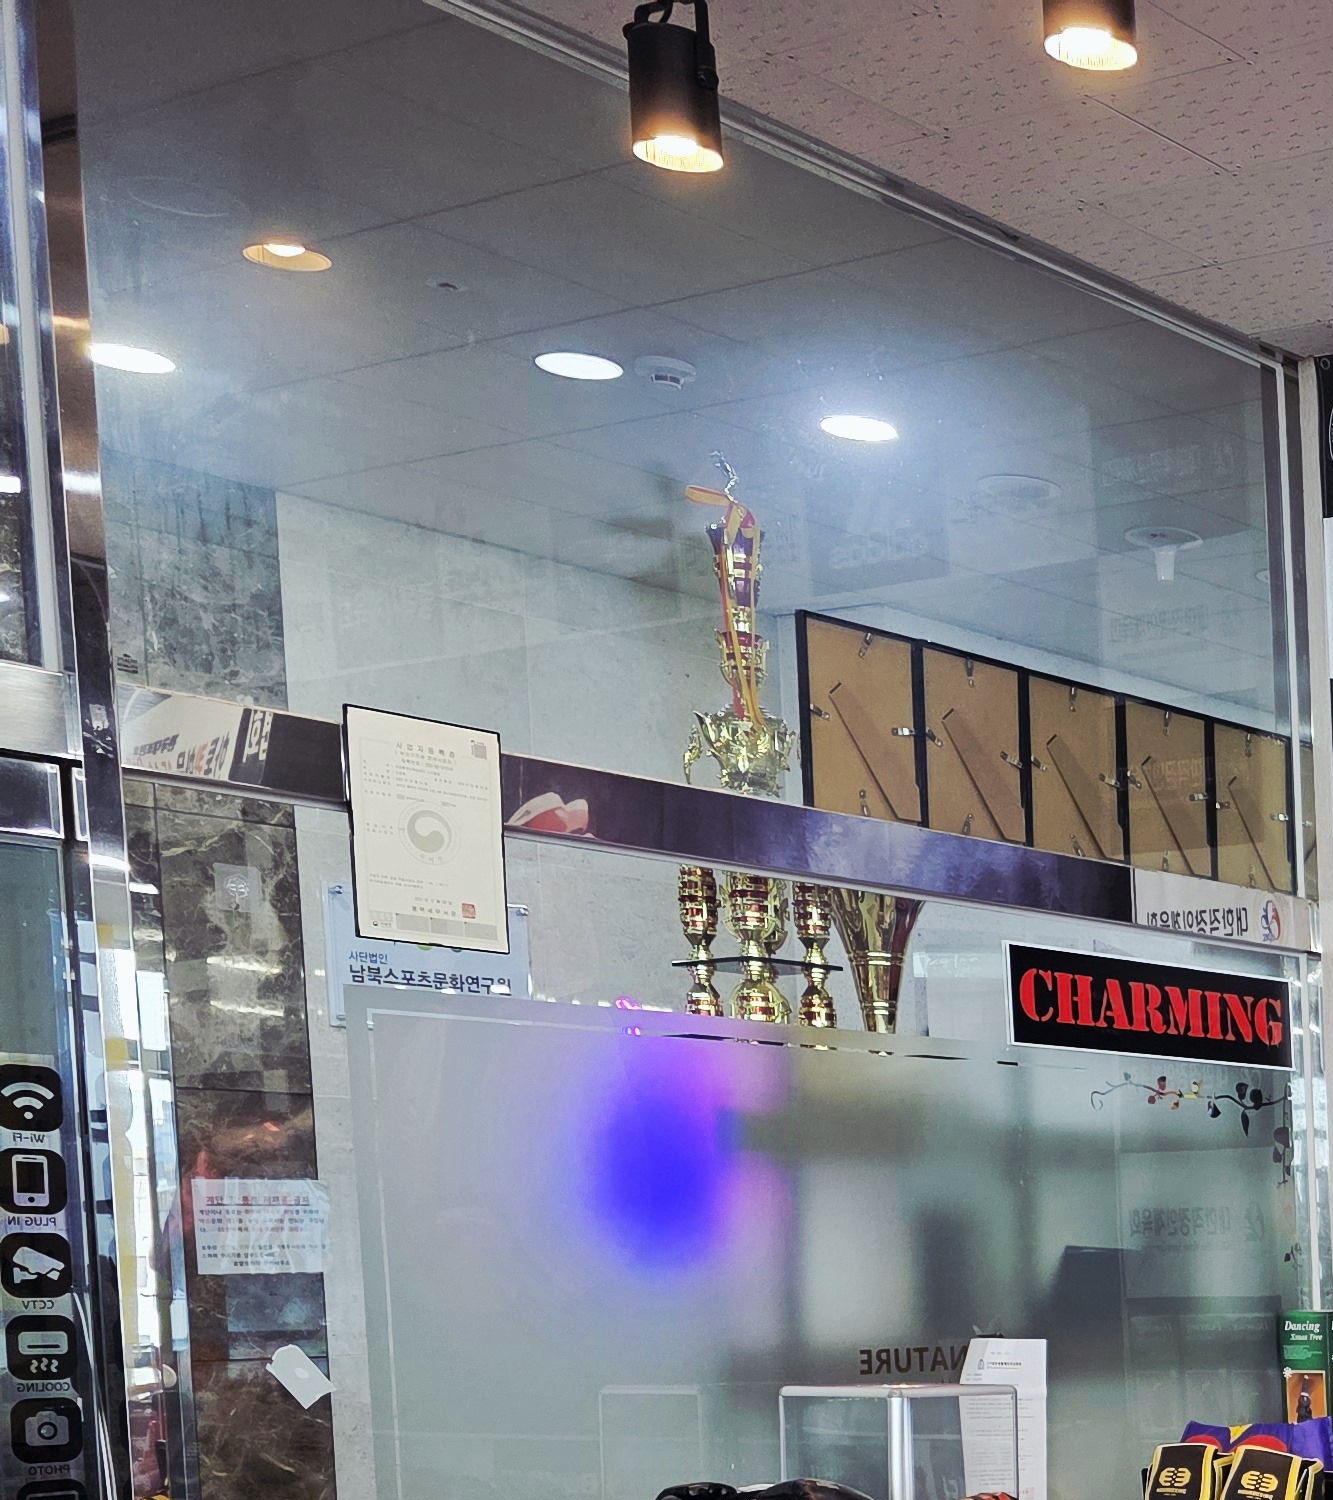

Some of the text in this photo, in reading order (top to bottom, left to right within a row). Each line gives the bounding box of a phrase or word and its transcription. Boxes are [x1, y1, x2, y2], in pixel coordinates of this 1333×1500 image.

[348, 951, 388, 965] 사단법인
[1019, 966, 1283, 1048] CHARMING
[1284, 1320, 1320, 1333] Dancing
